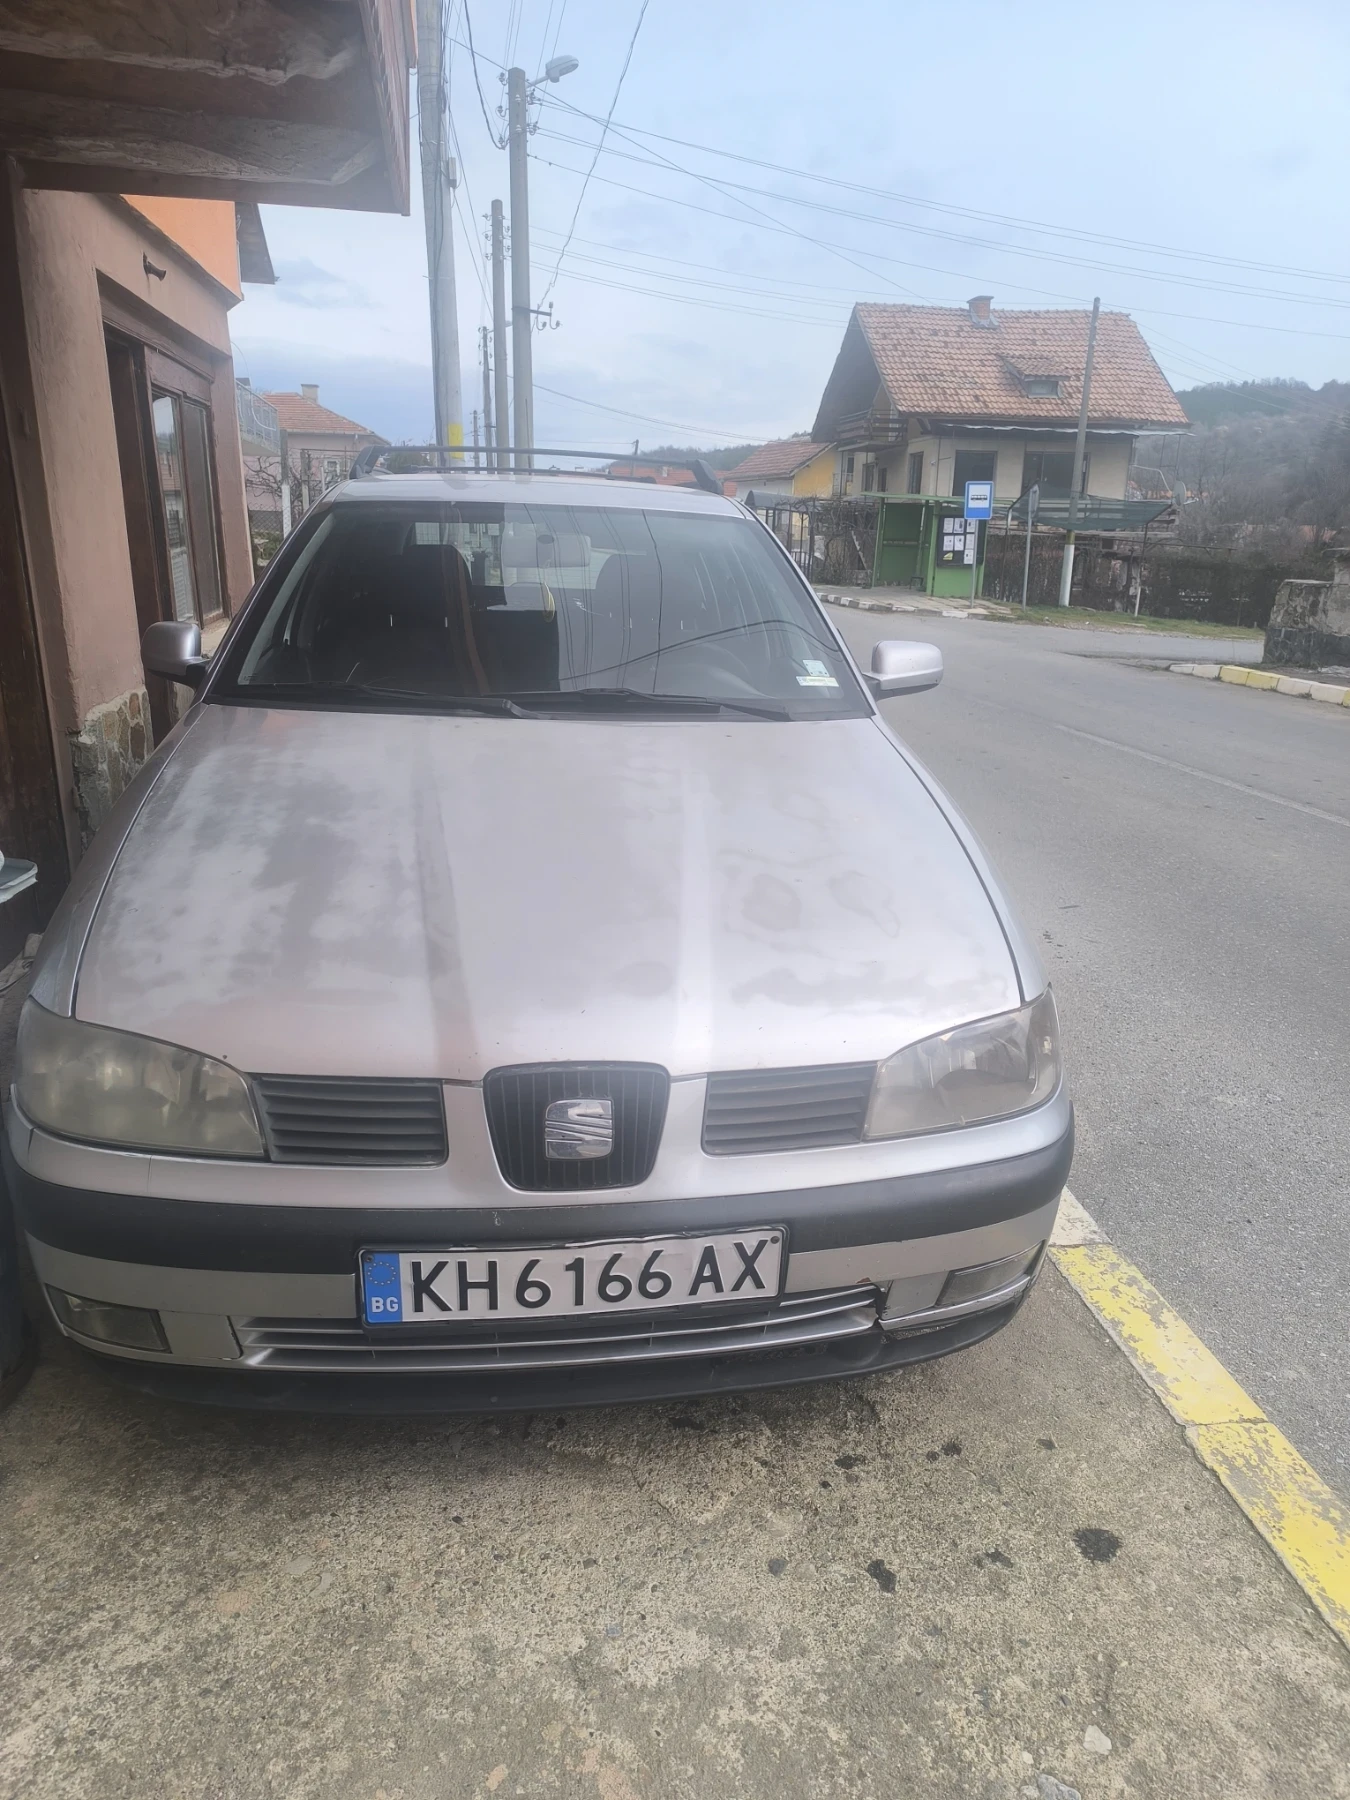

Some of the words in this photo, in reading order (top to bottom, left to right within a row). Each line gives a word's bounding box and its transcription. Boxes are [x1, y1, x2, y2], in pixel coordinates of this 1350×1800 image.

[411, 1260, 499, 1313] KH
[514, 1249, 673, 1309] 6166
[687, 1239, 770, 1296] AX
[371, 1296, 399, 1313] BG
